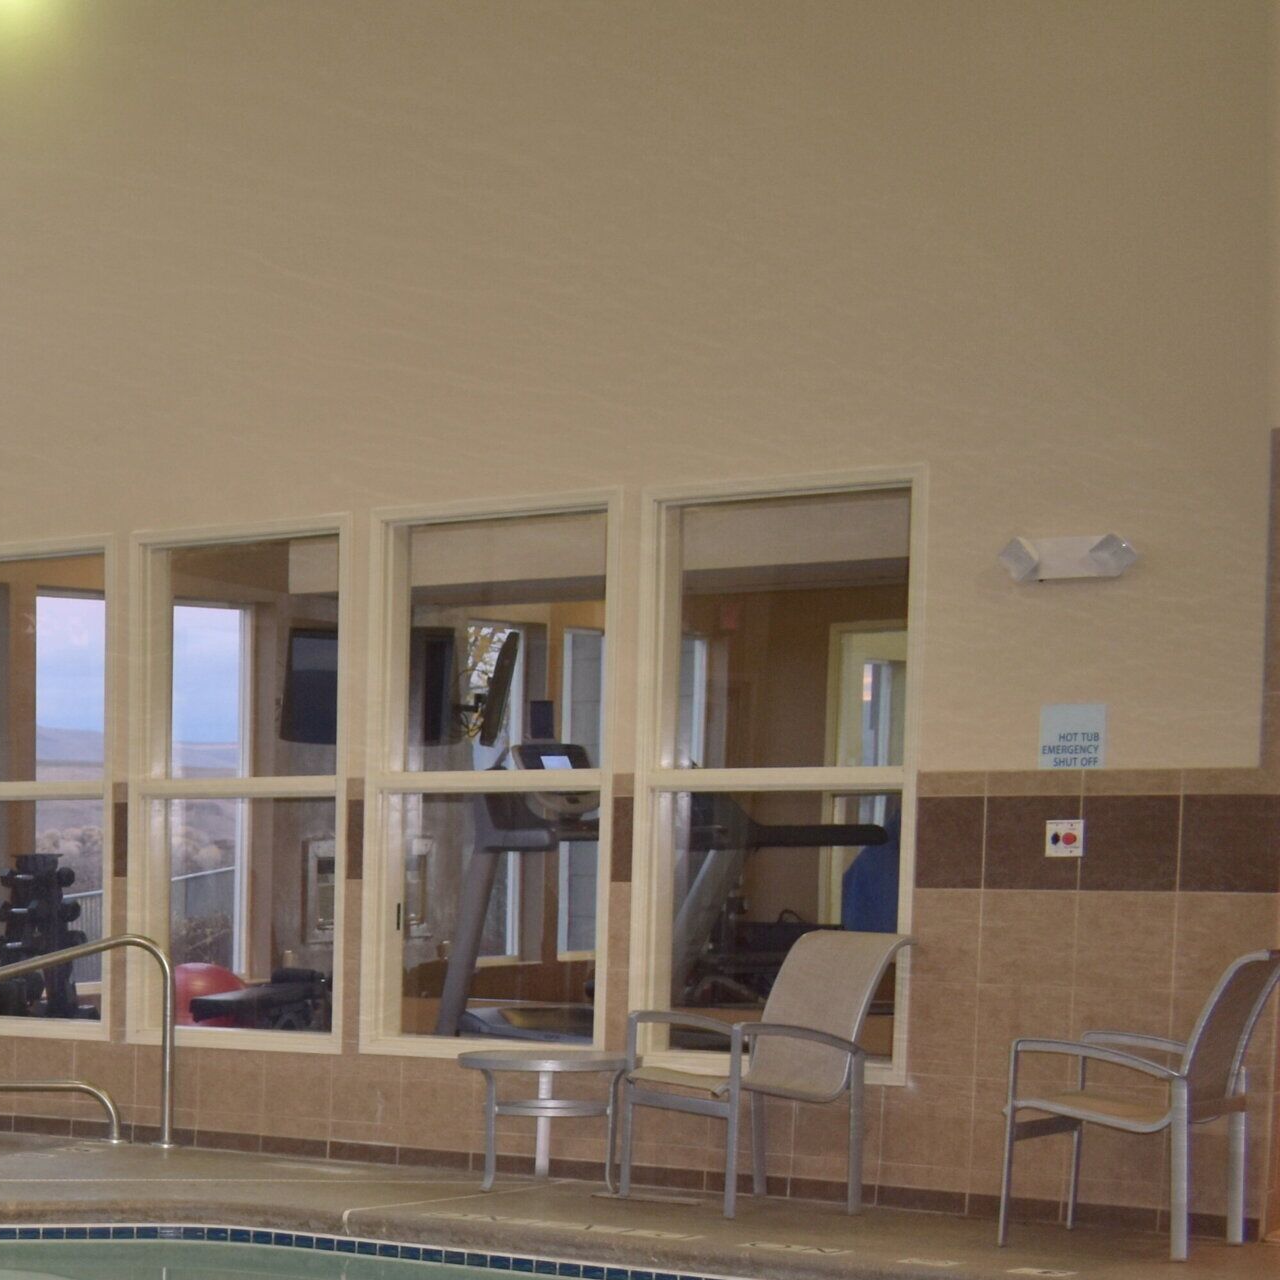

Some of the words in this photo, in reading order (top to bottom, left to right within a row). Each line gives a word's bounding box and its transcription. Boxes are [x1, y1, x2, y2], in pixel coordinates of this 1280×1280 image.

[1058, 732, 1079, 742] HOT
[1081, 731, 1100, 742] TUB
[1042, 744, 1099, 755] EMERGENCY
[1052, 757, 1079, 767] SHUT
[1080, 756, 1099, 767] OFF
